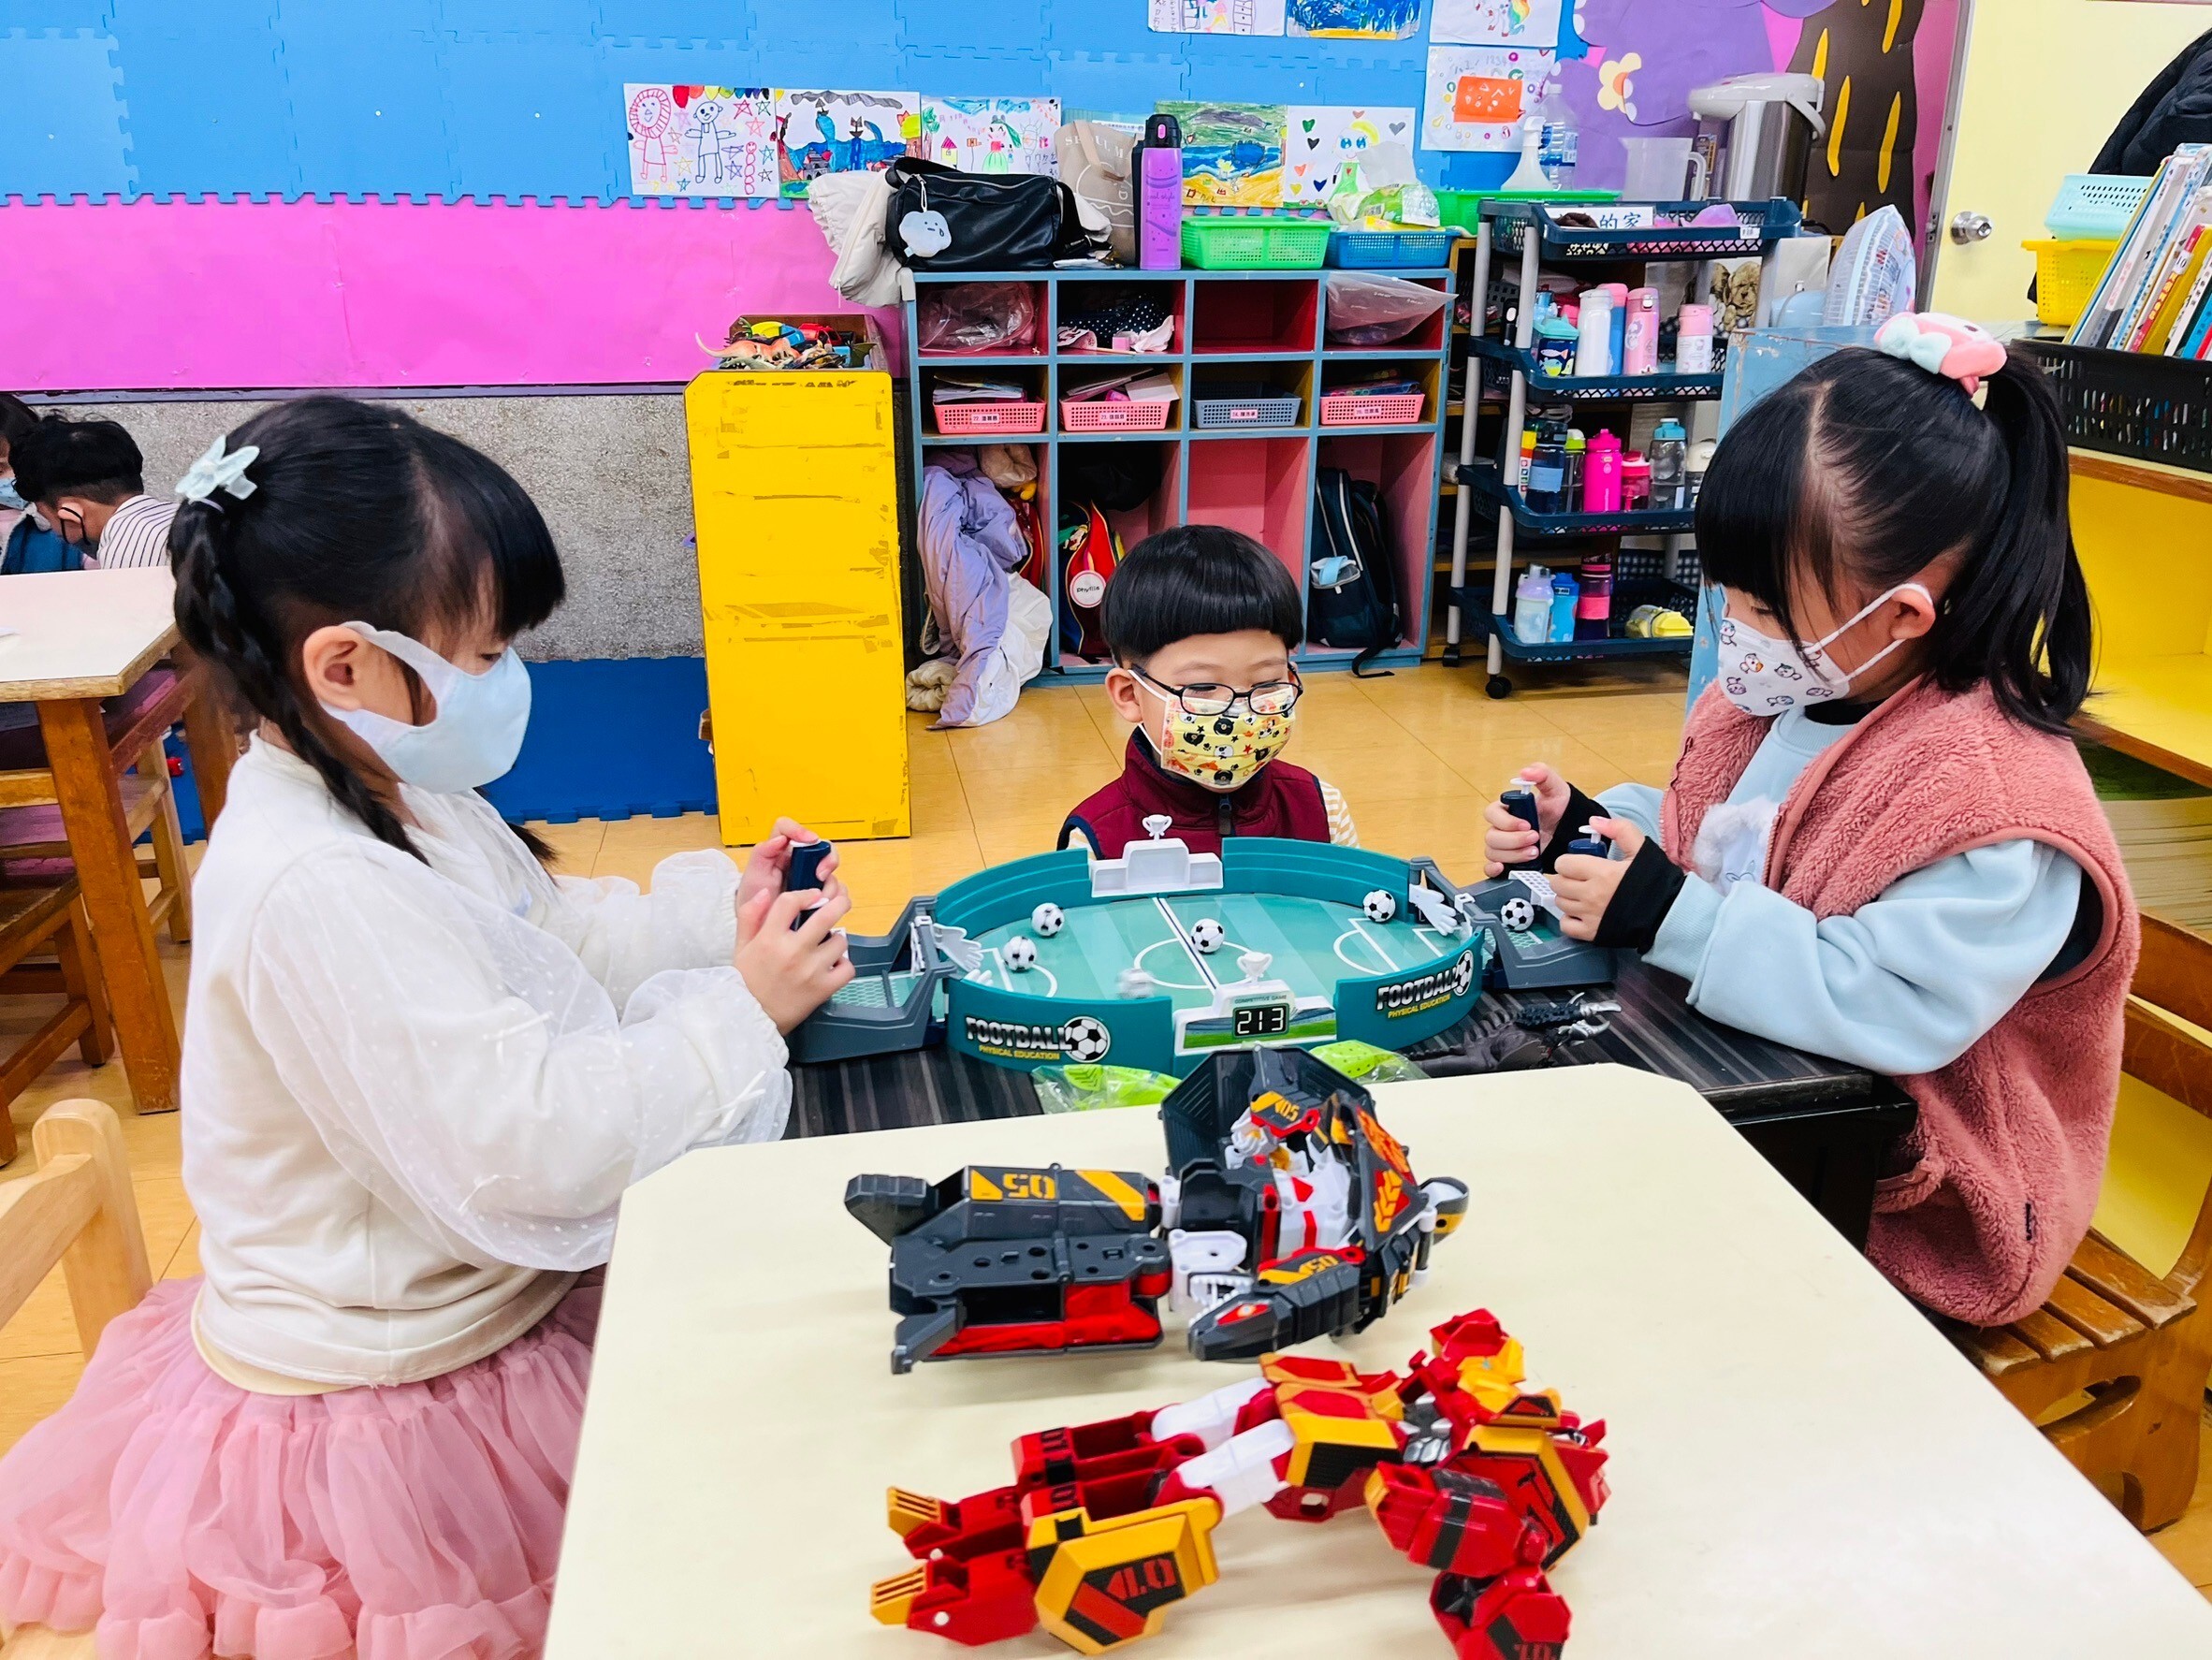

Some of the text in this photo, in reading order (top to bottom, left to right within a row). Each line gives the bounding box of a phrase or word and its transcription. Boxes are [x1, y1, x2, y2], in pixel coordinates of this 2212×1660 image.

[1599, 211, 1641, 229] 的家
[2176, 255, 2188, 269] 10
[1376, 967, 1459, 1011] FOOTBALL
[1388, 993, 1451, 1019] PHYSICAL EDUCATION
[966, 1016, 1073, 1051] FOOTBALL
[979, 1044, 1061, 1060] PHYSICAL EDUCATION
